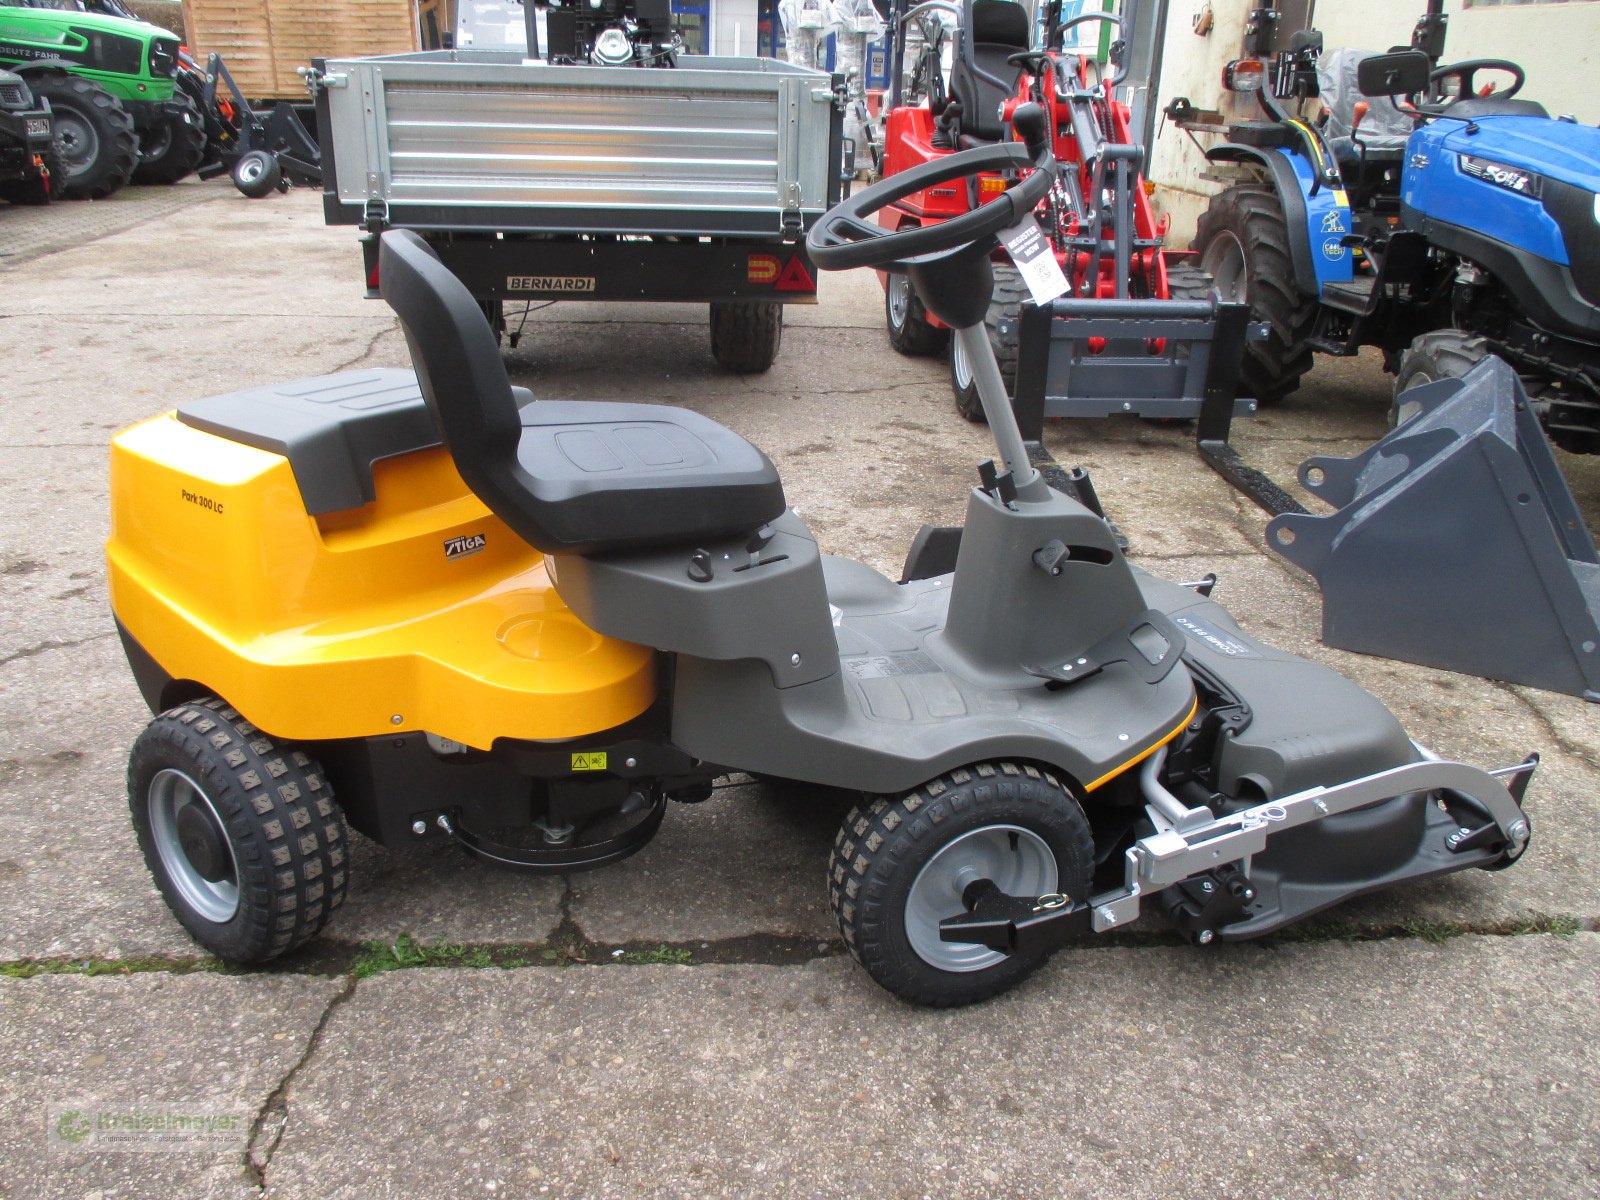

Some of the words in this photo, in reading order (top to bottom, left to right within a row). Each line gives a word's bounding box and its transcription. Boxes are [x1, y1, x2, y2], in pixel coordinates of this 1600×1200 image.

[1007, 225, 1039, 250] REGISTER
[1023, 242, 1040, 257] NOW
[511, 277, 592, 290] BERNARDI
[181, 488, 198, 505] Park
[198, 495, 213, 510] 300
[213, 501, 224, 514] LC
[446, 535, 486, 556] STIGA
